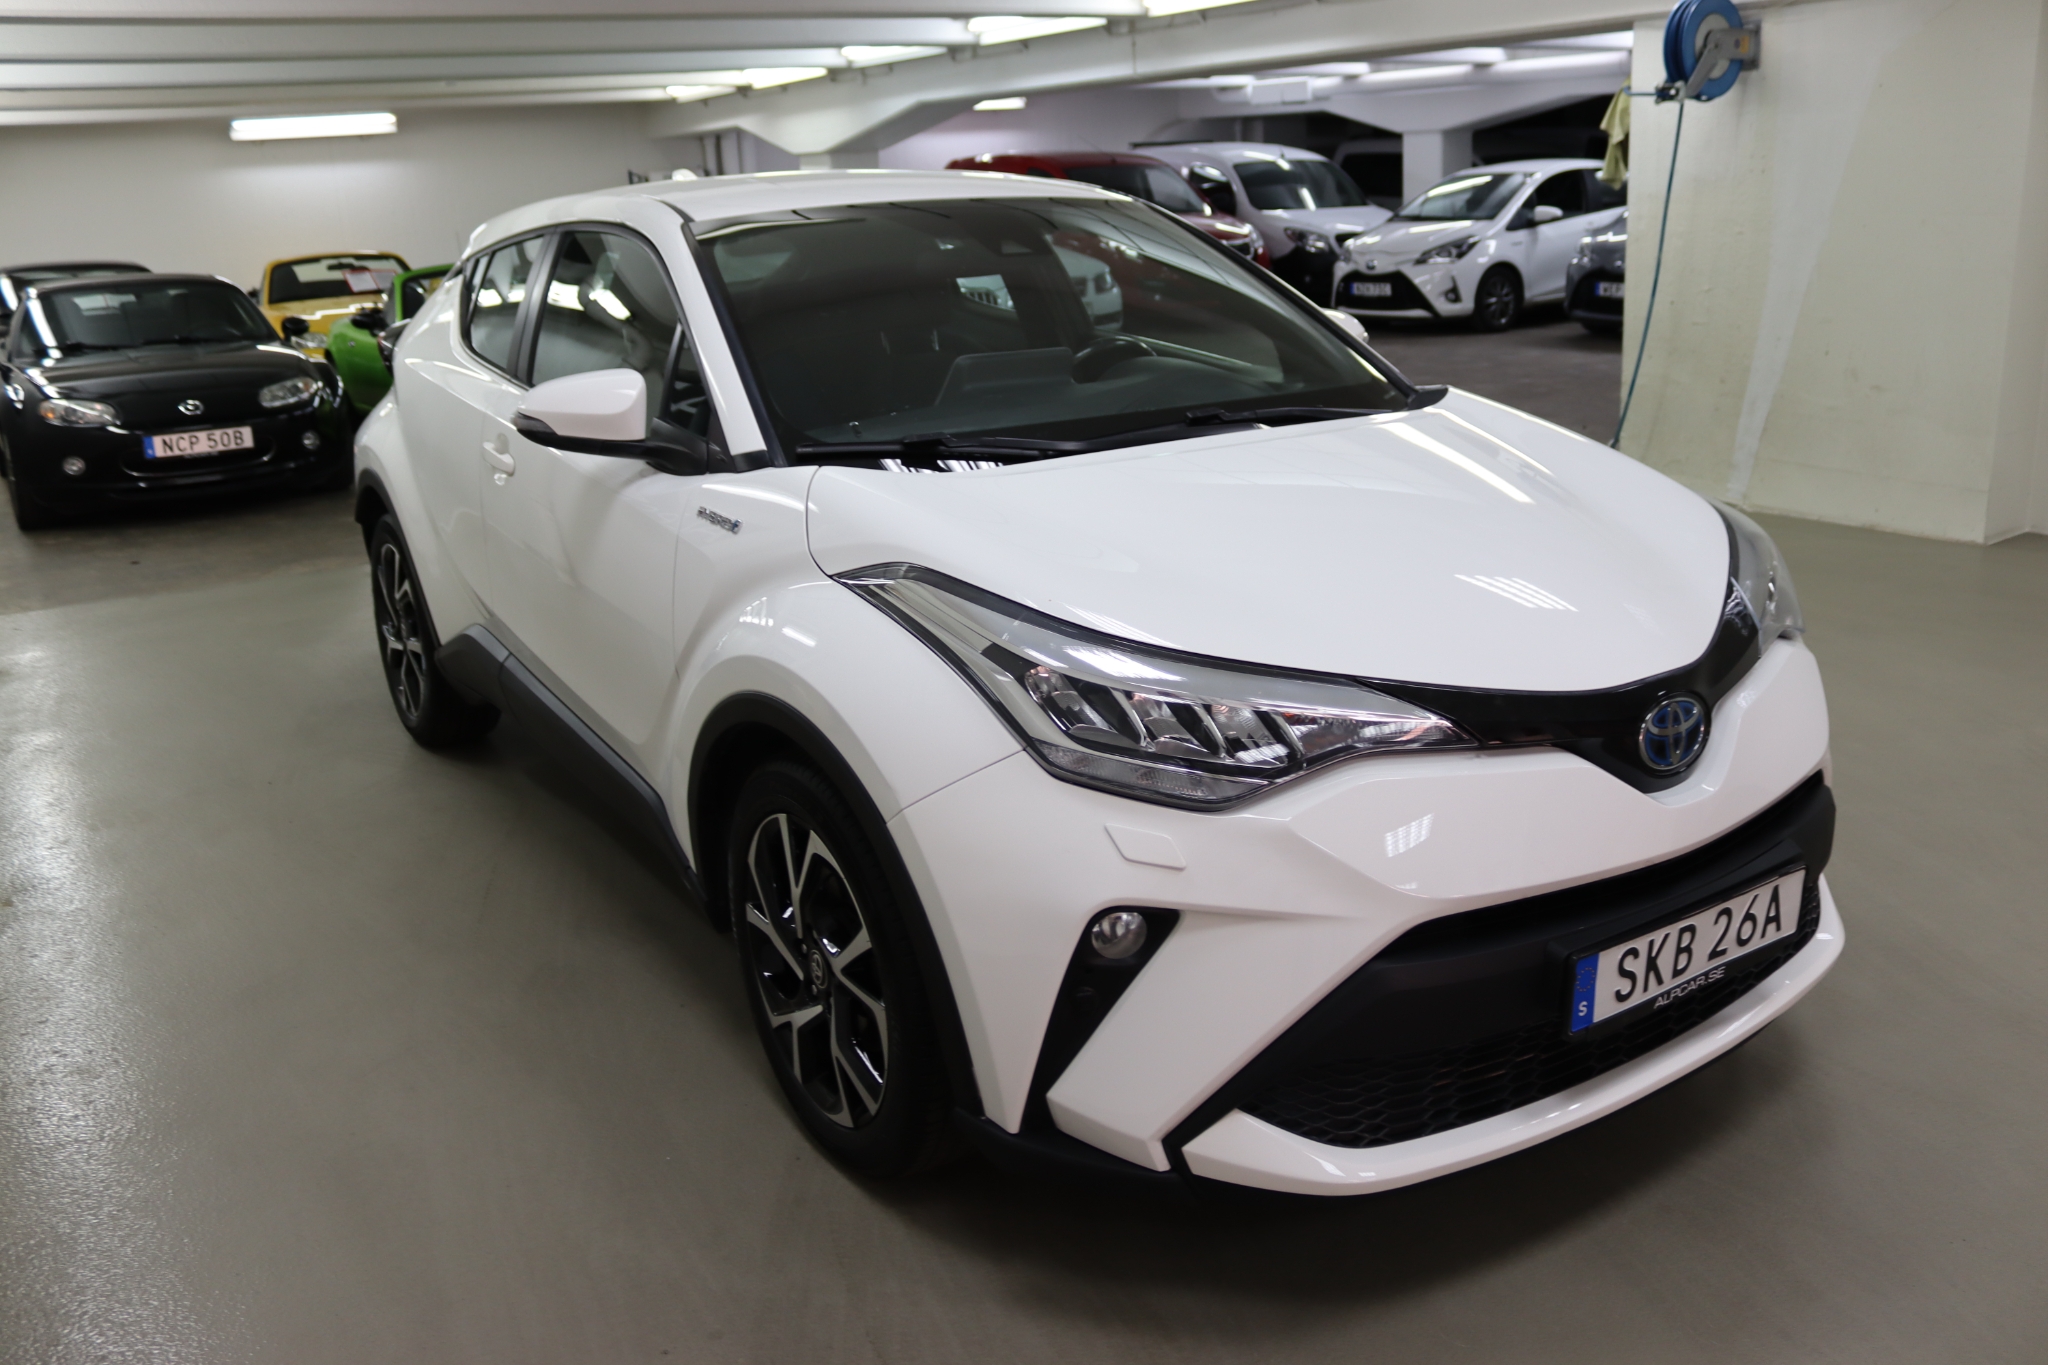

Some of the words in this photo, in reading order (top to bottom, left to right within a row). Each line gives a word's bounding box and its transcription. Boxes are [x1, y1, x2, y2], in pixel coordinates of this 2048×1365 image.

[162, 434, 200, 454] NCP
[1614, 923, 1697, 1003] SKB
[1707, 884, 1782, 962] 26A
[1653, 966, 1726, 1009] ALPCAR.SE
[1578, 1001, 1588, 1017] S
